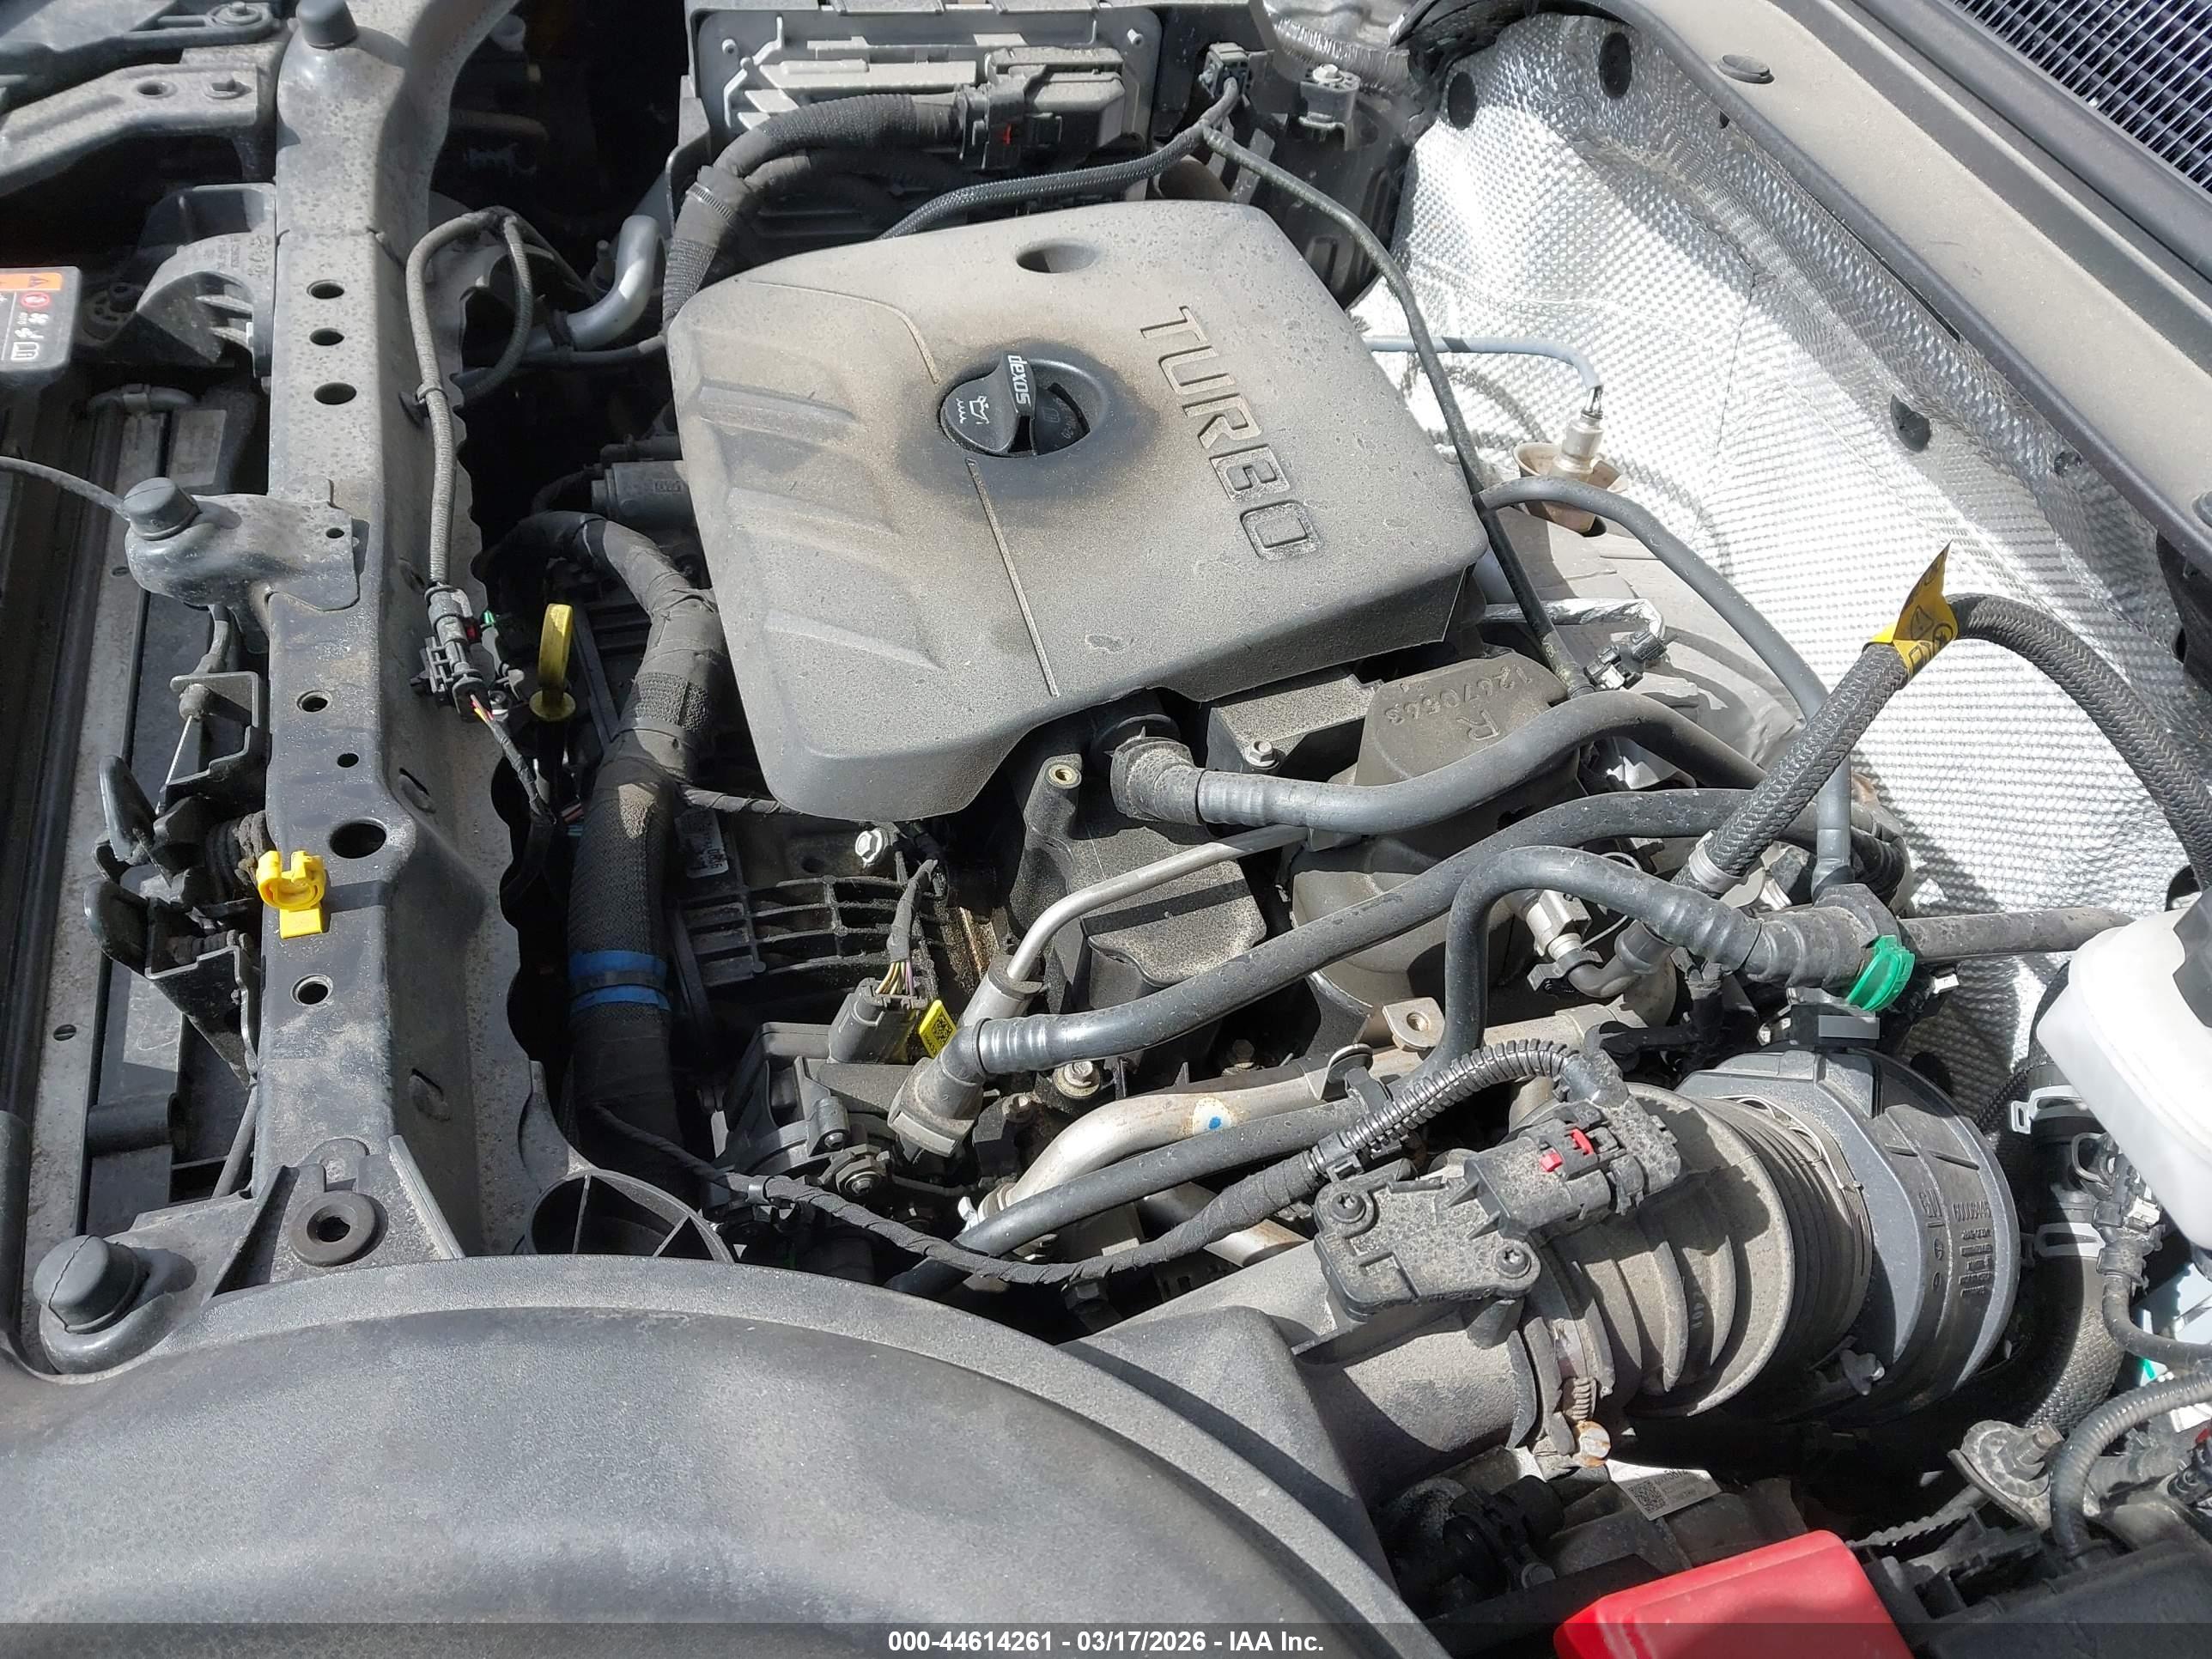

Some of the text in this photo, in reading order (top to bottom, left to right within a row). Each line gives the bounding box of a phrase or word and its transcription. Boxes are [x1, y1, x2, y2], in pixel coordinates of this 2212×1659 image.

[1007, 355, 1031, 407] dexos
[1139, 305, 1323, 560] TURBO
[1456, 708, 1500, 742] R
